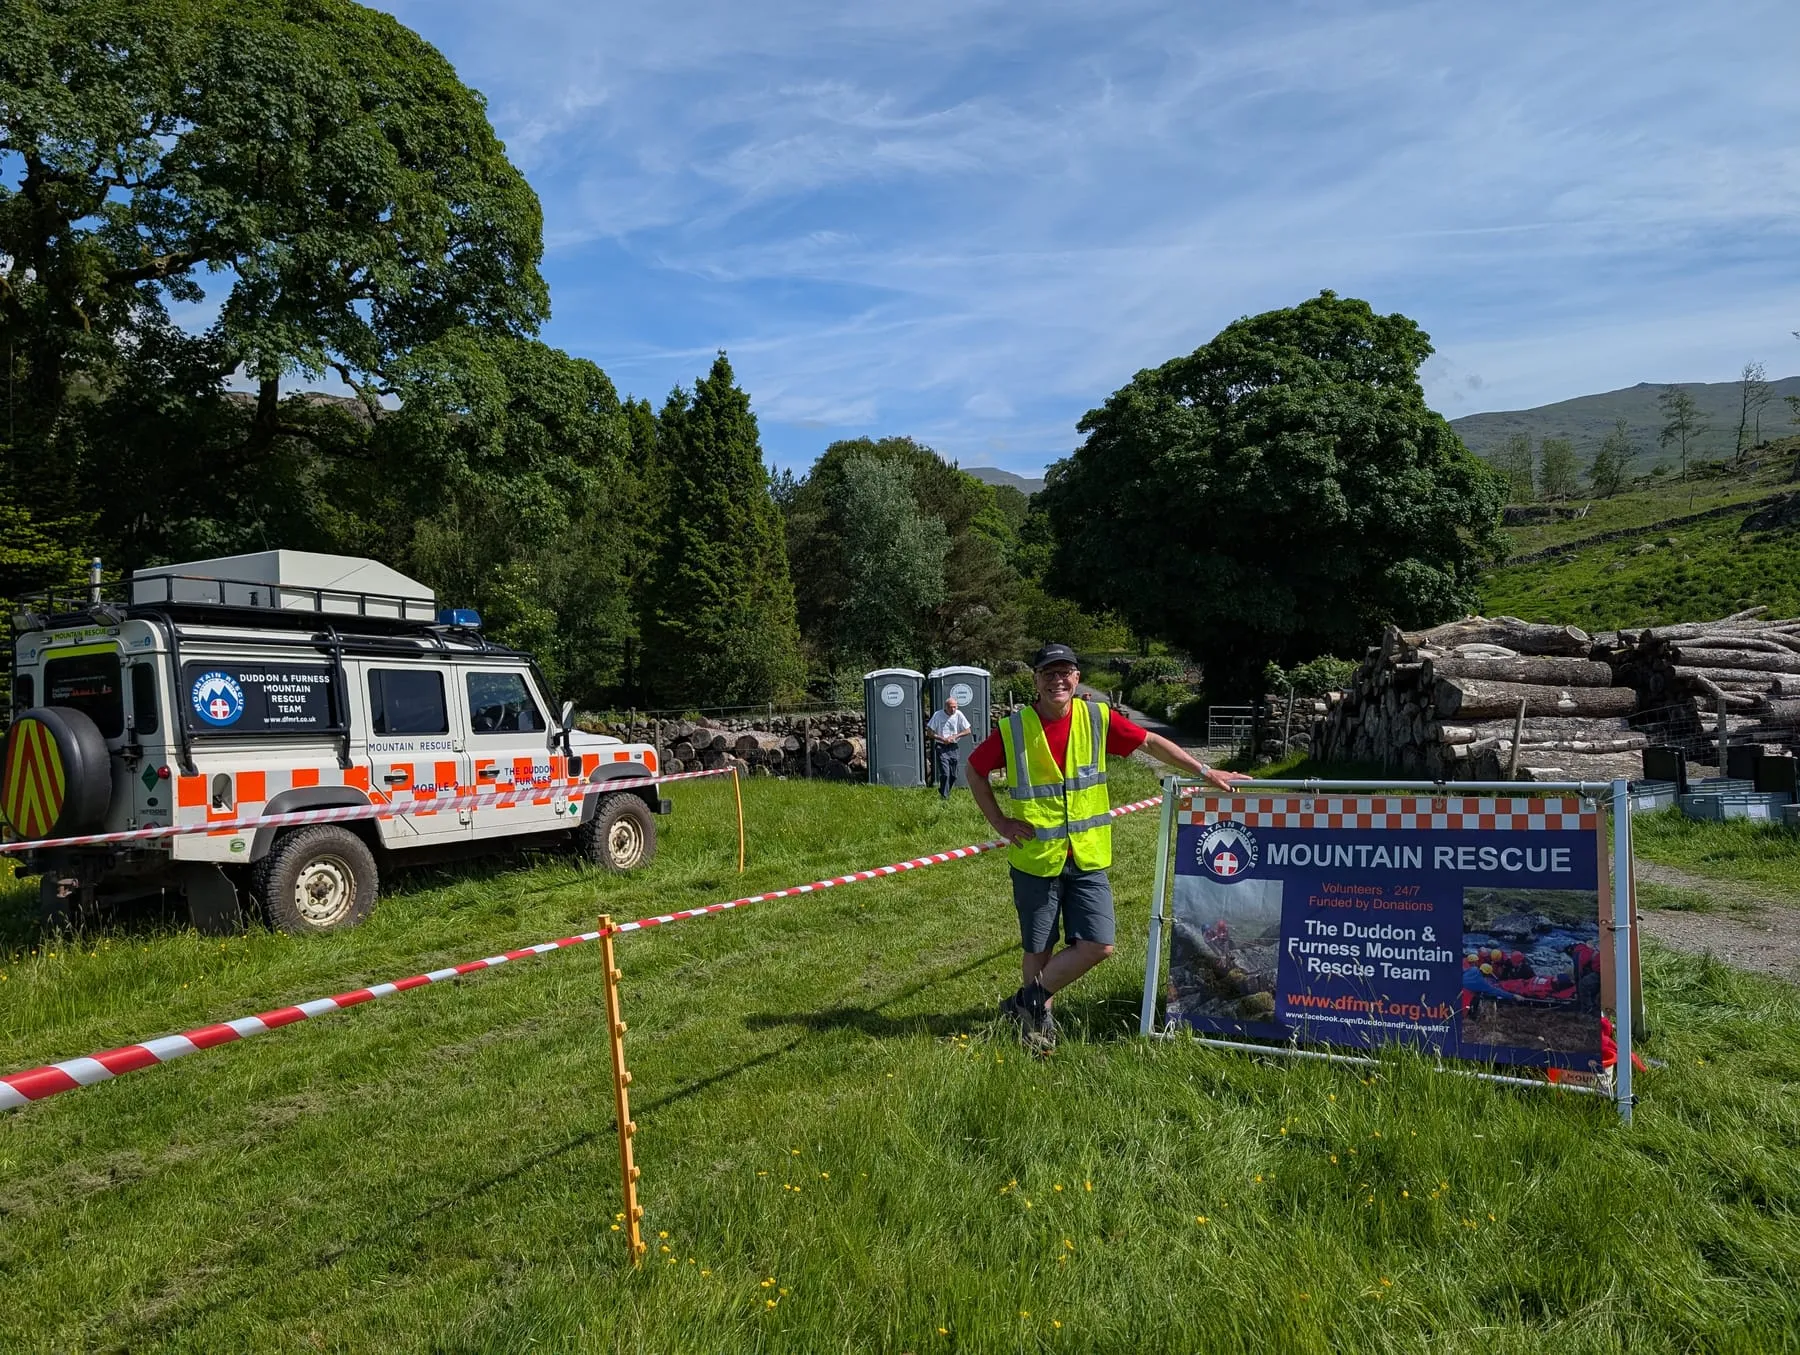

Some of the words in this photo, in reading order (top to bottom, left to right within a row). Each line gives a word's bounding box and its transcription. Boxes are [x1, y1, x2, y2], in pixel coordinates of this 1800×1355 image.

[54, 631, 83, 640] MOUNTAIN
[84, 628, 106, 637] RESCUE
[239, 674, 280, 683] DUDDON
[282, 674, 289, 683] &
[290, 674, 330, 684] FURNESS
[193, 672, 222, 712] MOUNTAIN
[226, 676, 244, 712] RESCUE
[263, 684, 311, 693] MOUNTAIN
[271, 695, 306, 703] RESCUE
[278, 705, 302, 713] TEAM
[368, 742, 414, 751] MOUNTAIN
[420, 741, 451, 750] RESCUE
[504, 766, 521, 776] THE
[523, 764, 555, 775] DUDDON
[515, 775, 552, 786] FURNESS
[411, 784, 448, 793] MOBILE
[452, 782, 459, 791] 2
[1195, 821, 1236, 866] MOUNTAIN
[1240, 825, 1259, 869] RESCUE
[1266, 843, 1422, 869] MOUNTAIN
[1434, 846, 1572, 873] RESCUE
[1322, 882, 1383, 895] Volunteers
[1394, 885, 1421, 896] 24/7
[1309, 895, 1353, 908] Funded
[1355, 897, 1370, 911] by
[1373, 898, 1434, 912] Donations
[1304, 920, 1338, 936] The
[1343, 922, 1416, 941] Duddon
[1421, 926, 1436, 942] &
[1288, 937, 1361, 957] Furness
[1366, 942, 1454, 962] Mountain
[1307, 957, 1375, 977] Rescue
[1380, 962, 1430, 981] Team
[1287, 993, 1449, 1021] www.dfmrt.org.uk
